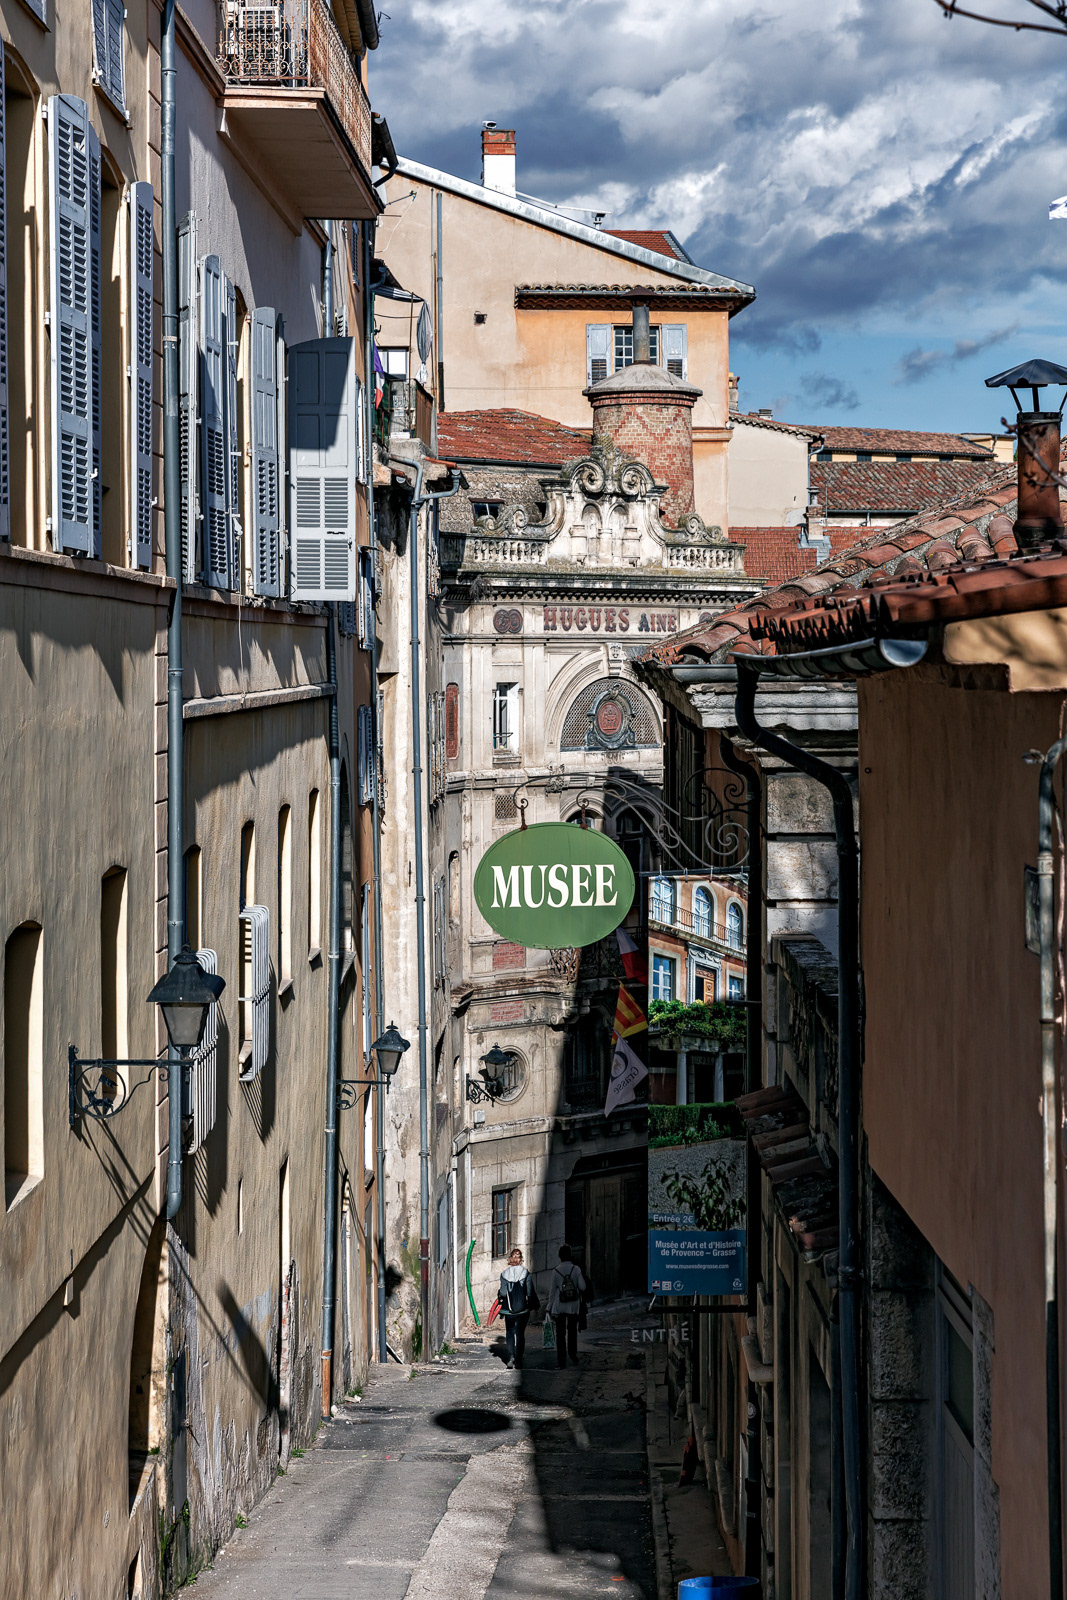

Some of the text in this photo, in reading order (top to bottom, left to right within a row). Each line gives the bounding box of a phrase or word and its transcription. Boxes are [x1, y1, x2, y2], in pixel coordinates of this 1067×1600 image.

[544, 607, 629, 632] HUGUES
[490, 863, 618, 908] MUSEE
[653, 1213, 694, 1223] Entrée 2€
[655, 1240, 679, 1249] Musée
[680, 1241, 698, 1249] d'Art
[708, 1240, 742, 1249] d'Histoire
[660, 1248, 670, 1256] de
[671, 1248, 704, 1257] Provence
[712, 1248, 737, 1257] Grasse
